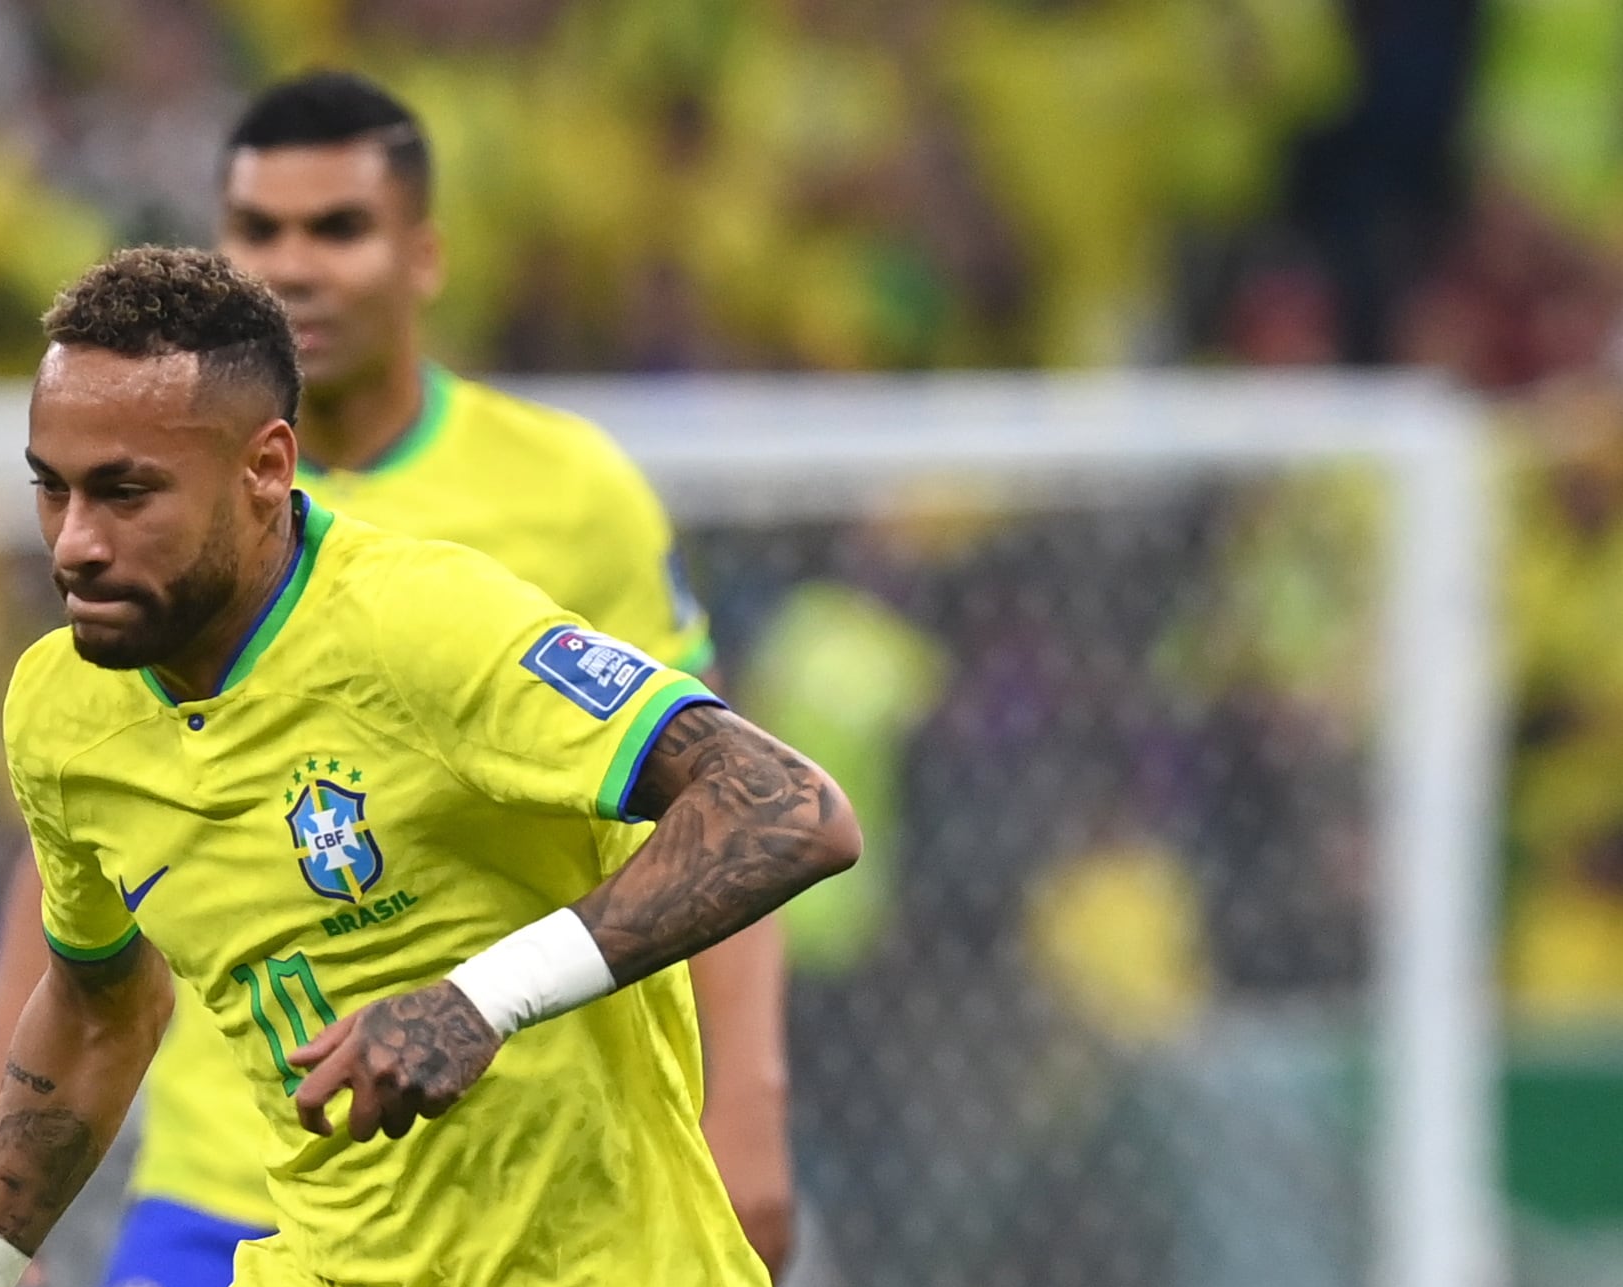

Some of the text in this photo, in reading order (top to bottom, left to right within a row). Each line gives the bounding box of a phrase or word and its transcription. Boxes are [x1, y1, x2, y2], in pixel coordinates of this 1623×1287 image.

[313, 829, 346, 850] CBF
[320, 889, 419, 937] BRASIL
[229, 951, 338, 1099] 10
